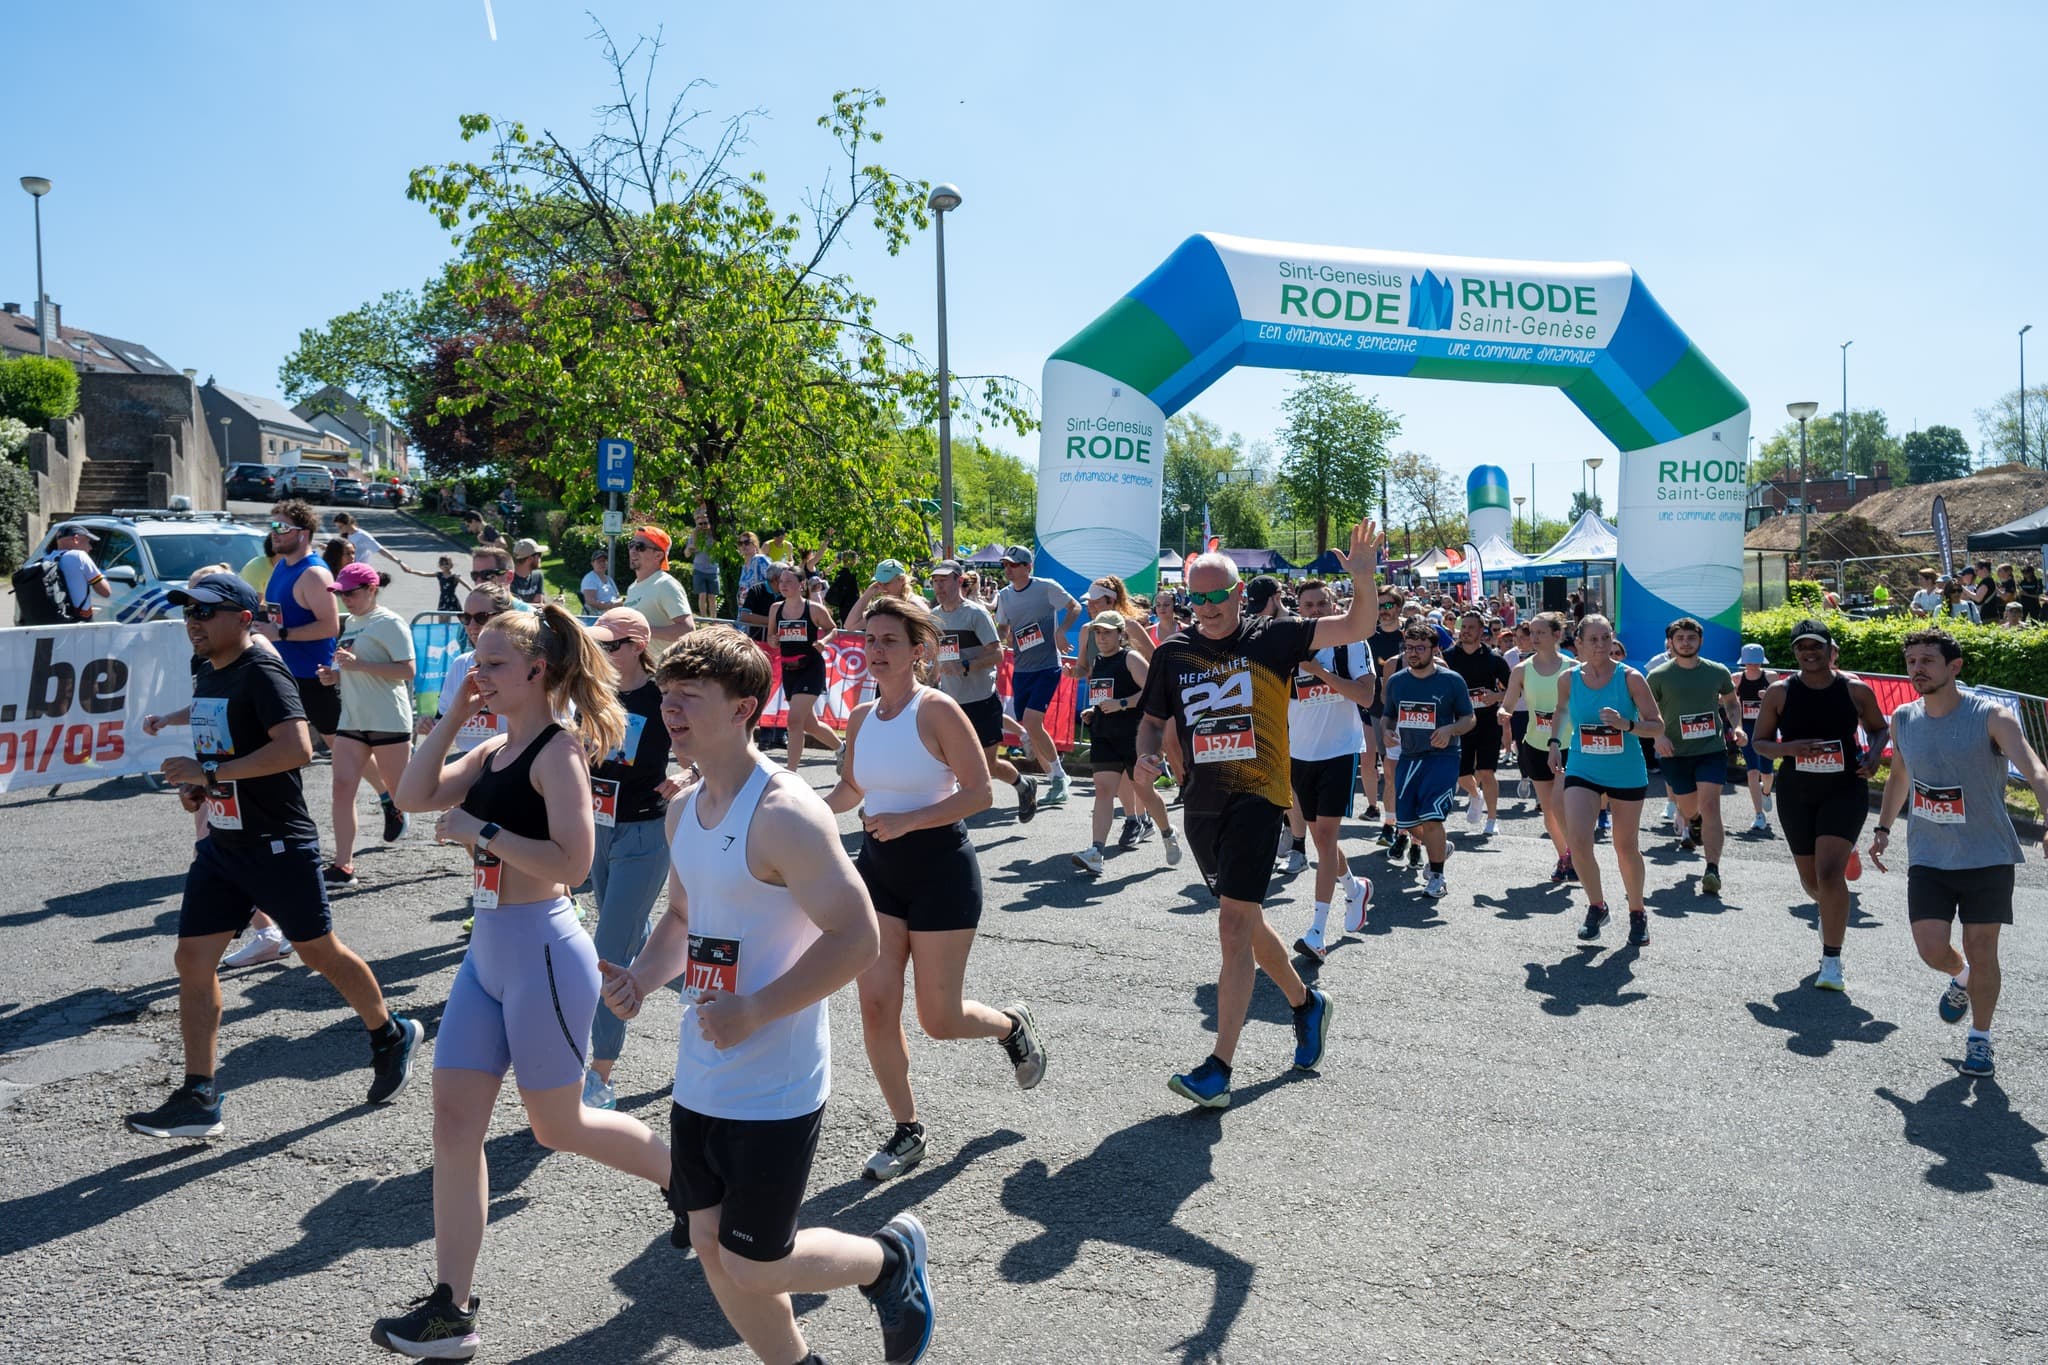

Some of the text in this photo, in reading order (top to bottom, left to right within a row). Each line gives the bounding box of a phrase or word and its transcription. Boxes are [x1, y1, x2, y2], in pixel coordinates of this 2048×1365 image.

[1279, 261, 1402, 288] Sint-Genesius
[1280, 284, 1401, 325] RODE
[1461, 278, 1597, 316] RHODE
[1259, 324, 1418, 353] Een dynamische gemeente
[1459, 312, 1597, 340] Saint-Genèse
[1474, 346, 1533, 361] commune
[1537, 347, 1596, 365] dynamique
[1066, 417, 1153, 437] Sint-Genesius
[607, 443, 627, 470] P
[1066, 435, 1151, 464] RODE
[1659, 460, 1746, 484] RHODE
[0, 637, 129, 722] .be
[1405, 711, 1430, 722] 1489
[0, 721, 125, 775] 01/05
[1204, 733, 1241, 751] 1527
[1592, 735, 1610, 747] 531
[1920, 796, 1952, 814] 1063
[692, 964, 724, 991] 1774
